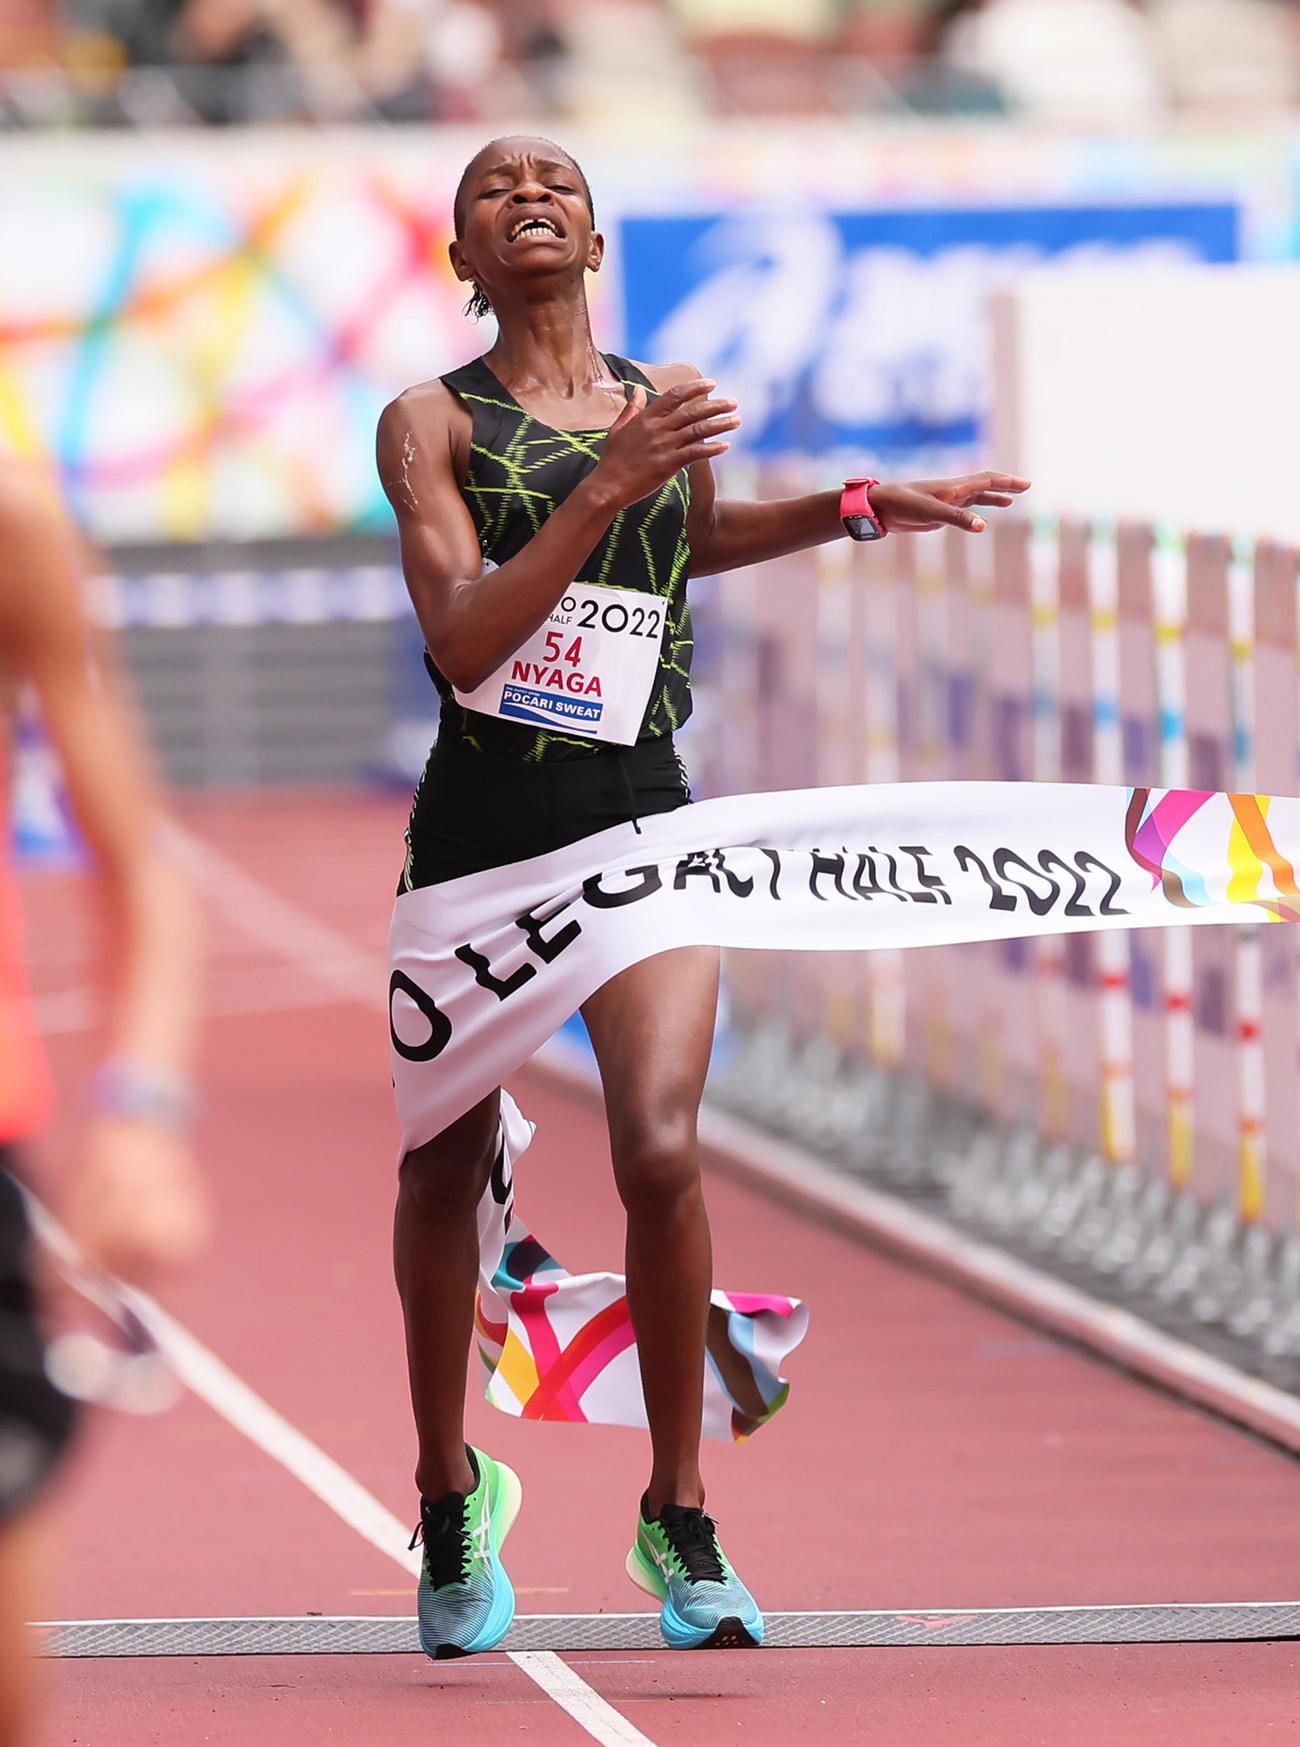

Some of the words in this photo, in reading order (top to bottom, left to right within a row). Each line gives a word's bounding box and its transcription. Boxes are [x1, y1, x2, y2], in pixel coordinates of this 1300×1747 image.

[577, 600, 660, 639] 2022
[543, 631, 582, 667] 54
[511, 661, 602, 697] NYAGA
[504, 691, 554, 710] POCARI
[555, 702, 601, 719] SWEAT
[808, 846, 952, 905] HALF
[953, 844, 1131, 917] 2022
